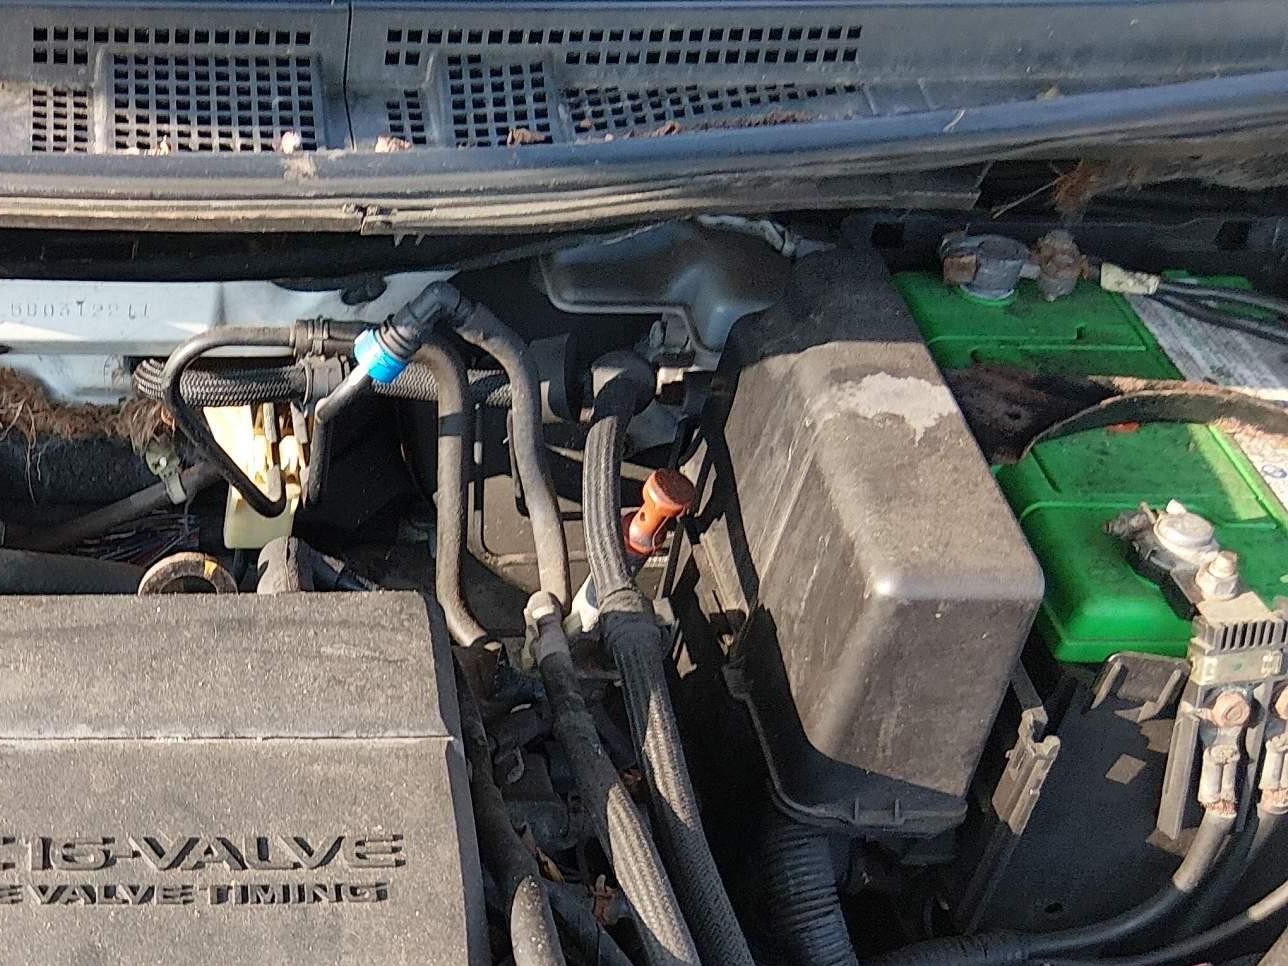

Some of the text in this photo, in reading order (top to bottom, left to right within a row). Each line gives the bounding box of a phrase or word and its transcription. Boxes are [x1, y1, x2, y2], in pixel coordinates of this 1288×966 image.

[28, 835, 407, 871] 16-VALVE
[27, 883, 194, 905] VALVE
[199, 882, 390, 905] TIMING
